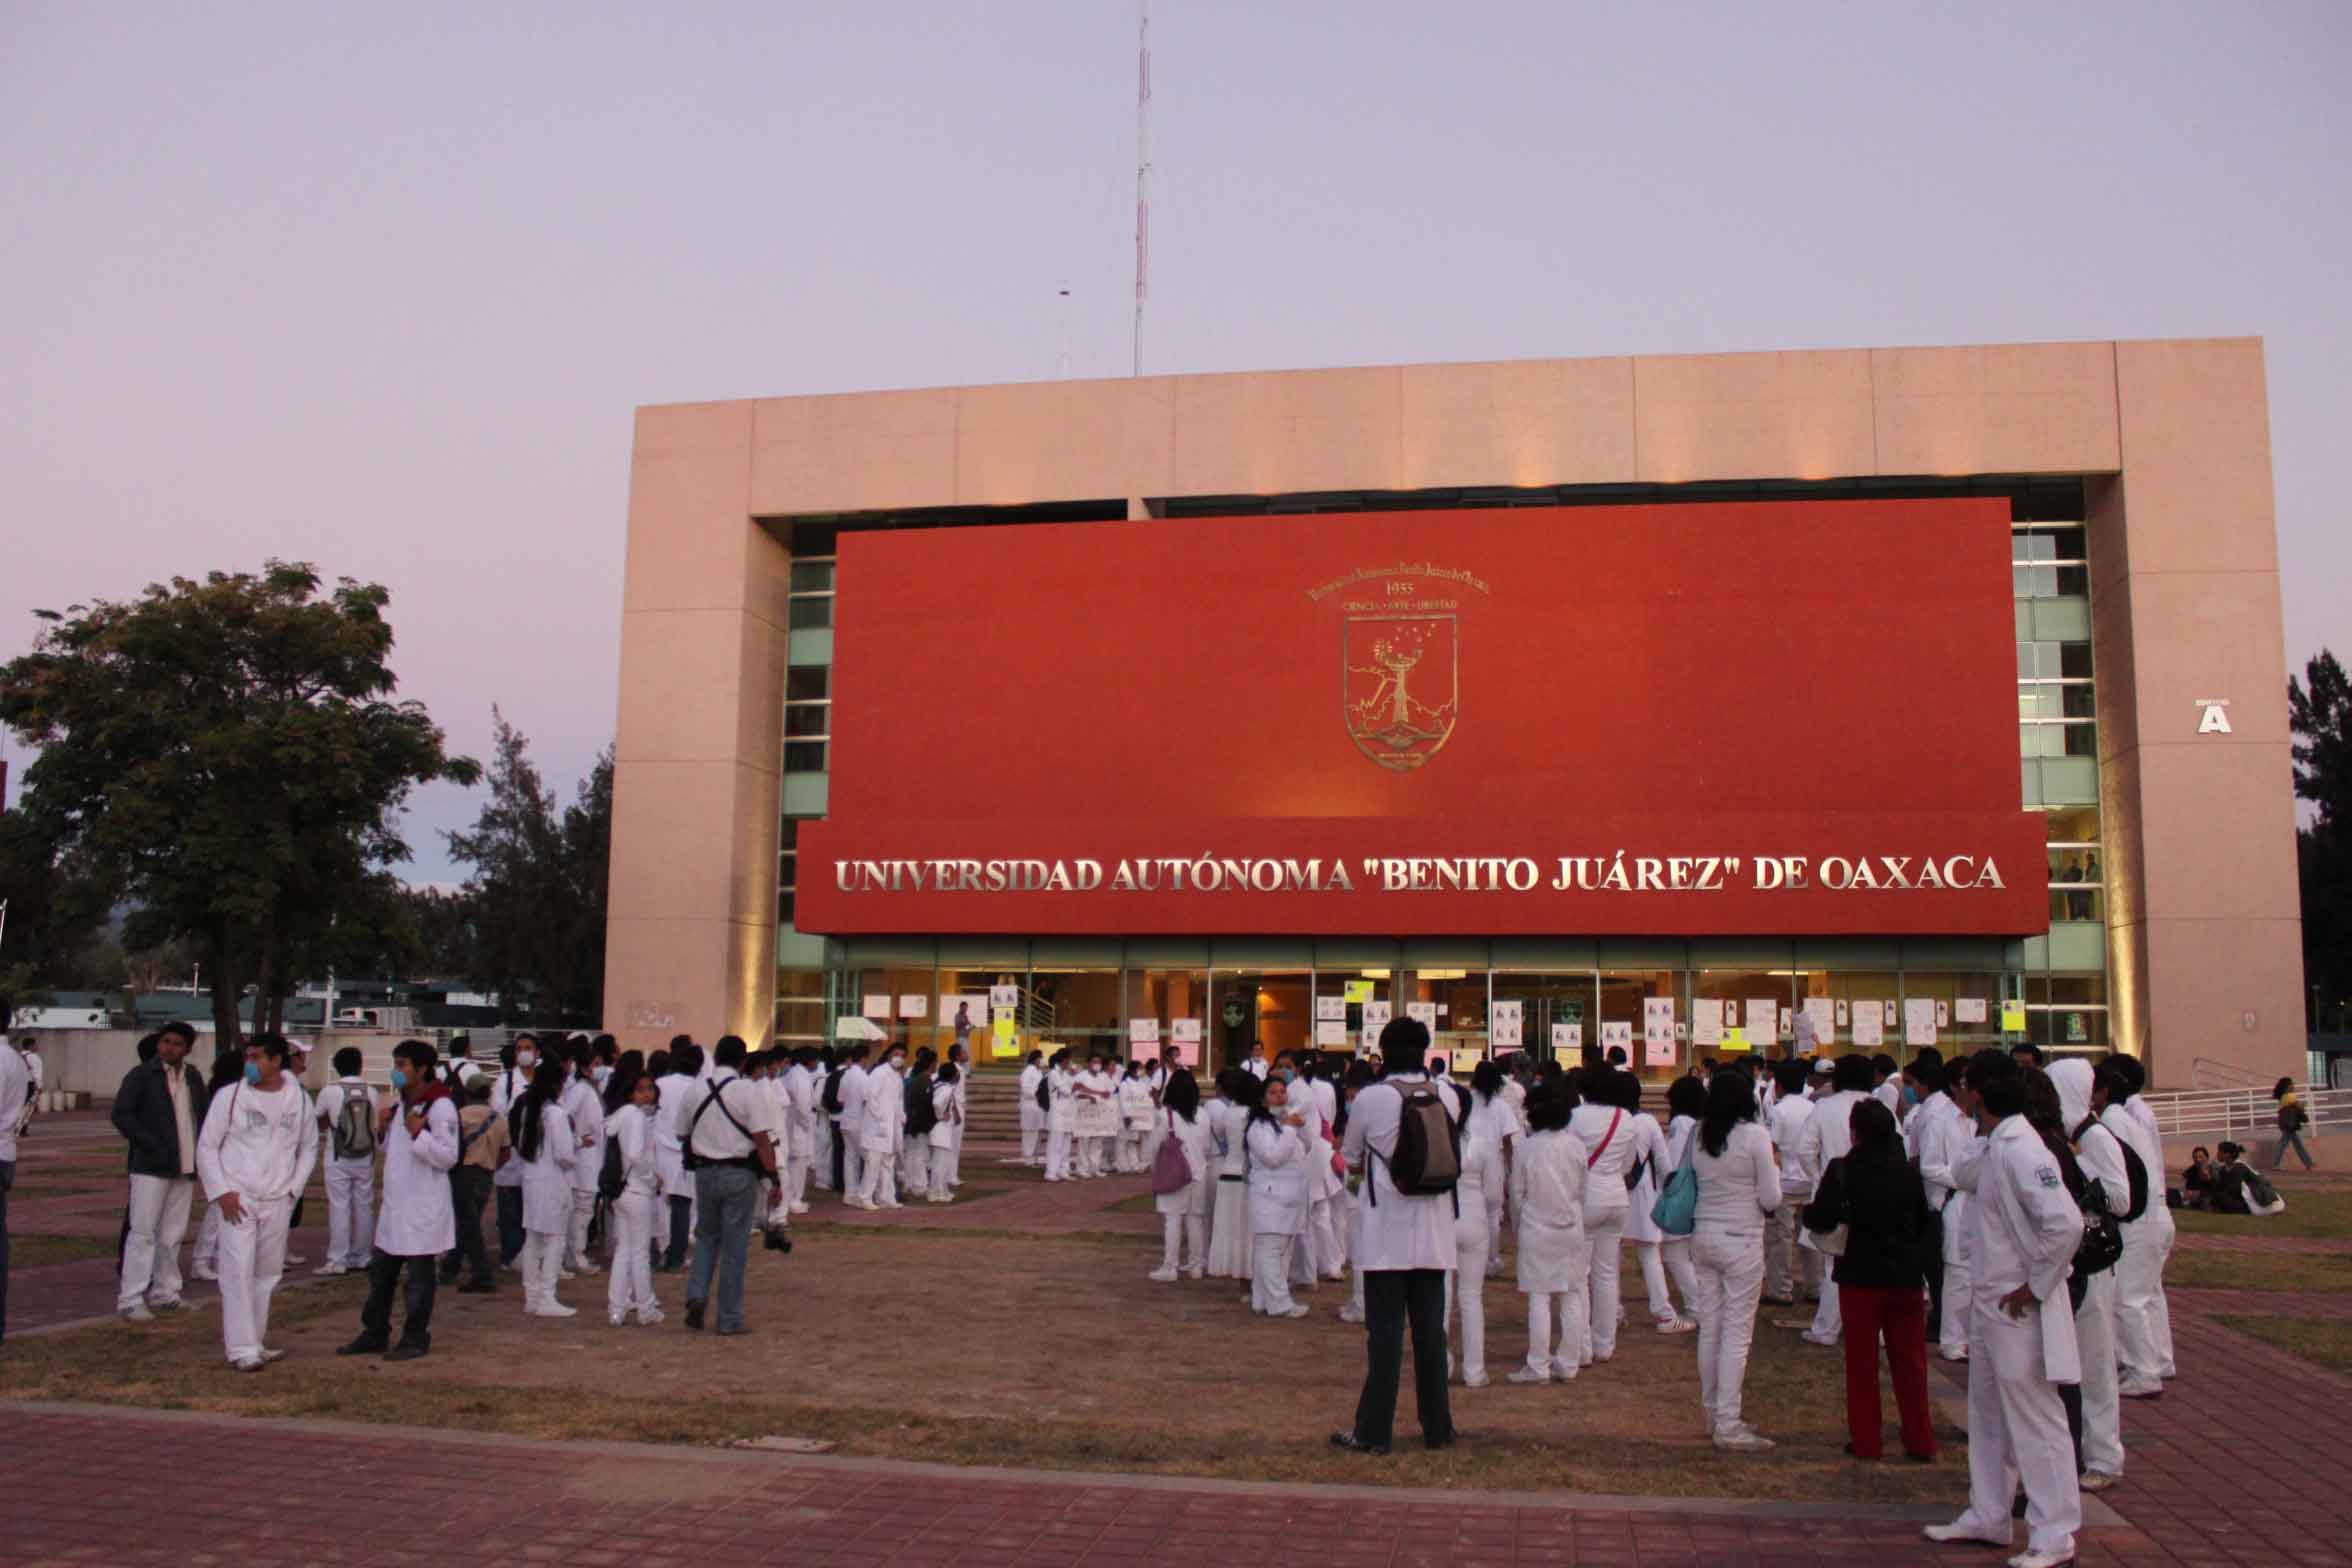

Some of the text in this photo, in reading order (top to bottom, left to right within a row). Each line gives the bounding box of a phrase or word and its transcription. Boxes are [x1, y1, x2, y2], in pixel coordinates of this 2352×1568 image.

[2194, 699, 2232, 734] A
[833, 848, 2007, 892] UNIVERSIDAD AUTÓNOMA "BENITO JUÁREZ" DE OAXACA
